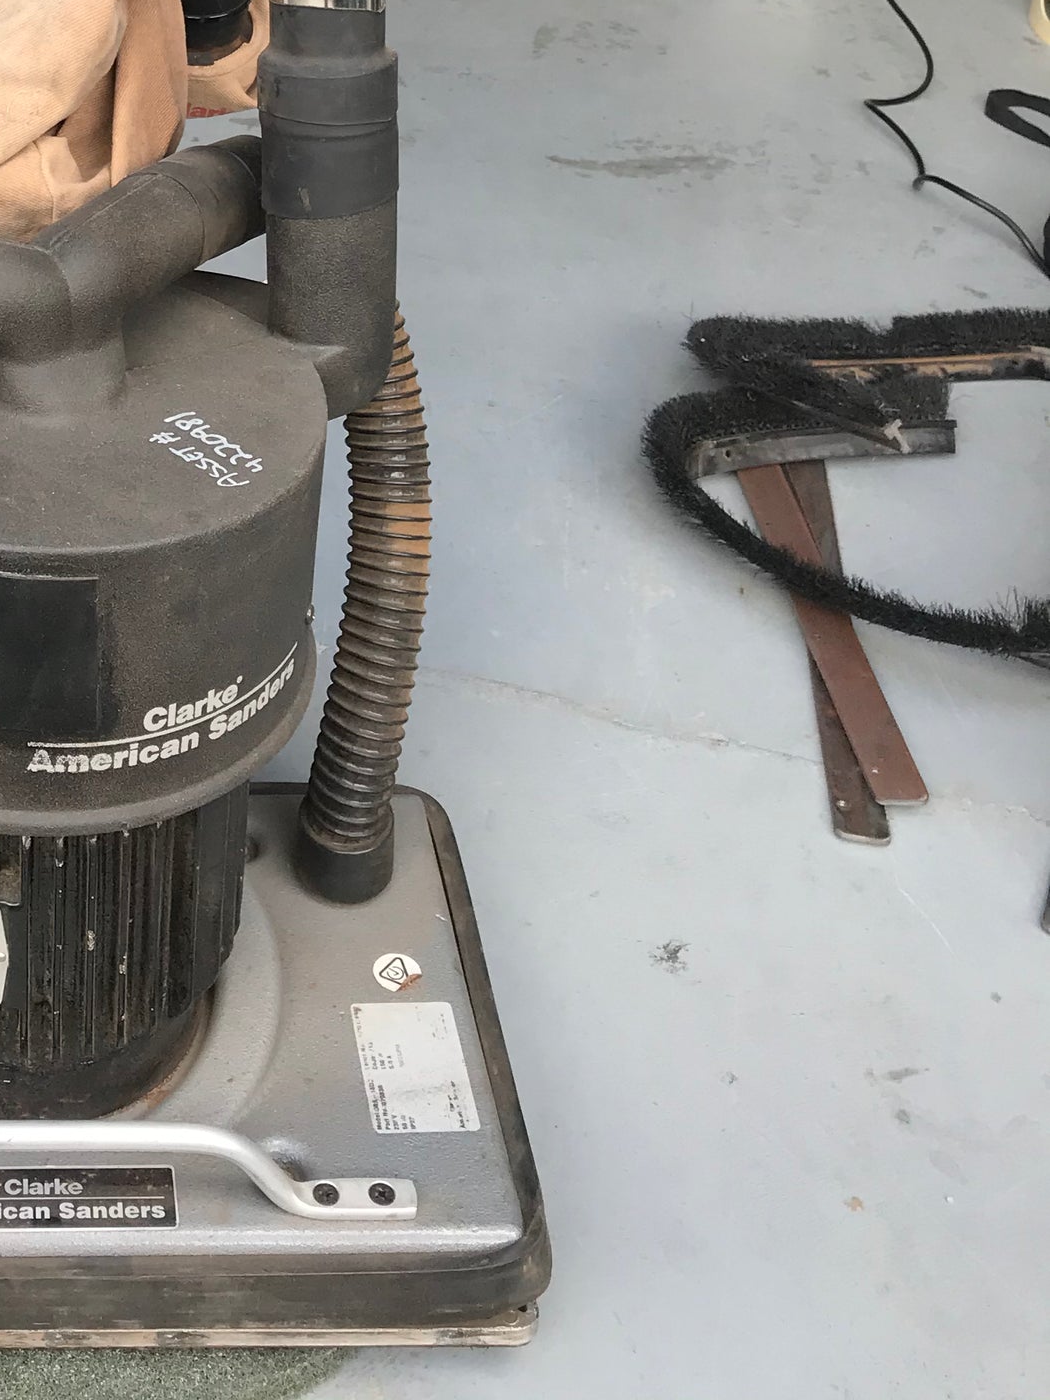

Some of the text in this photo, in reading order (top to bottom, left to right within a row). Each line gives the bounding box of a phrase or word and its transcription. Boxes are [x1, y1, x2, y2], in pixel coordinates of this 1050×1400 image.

[168, 446, 250, 487] ASSET
[26, 658, 295, 774] American Sanders
[143, 682, 240, 733] Clarke
[4, 1178, 83, 1196] Clarke
[59, 1200, 166, 1220] Sanders
